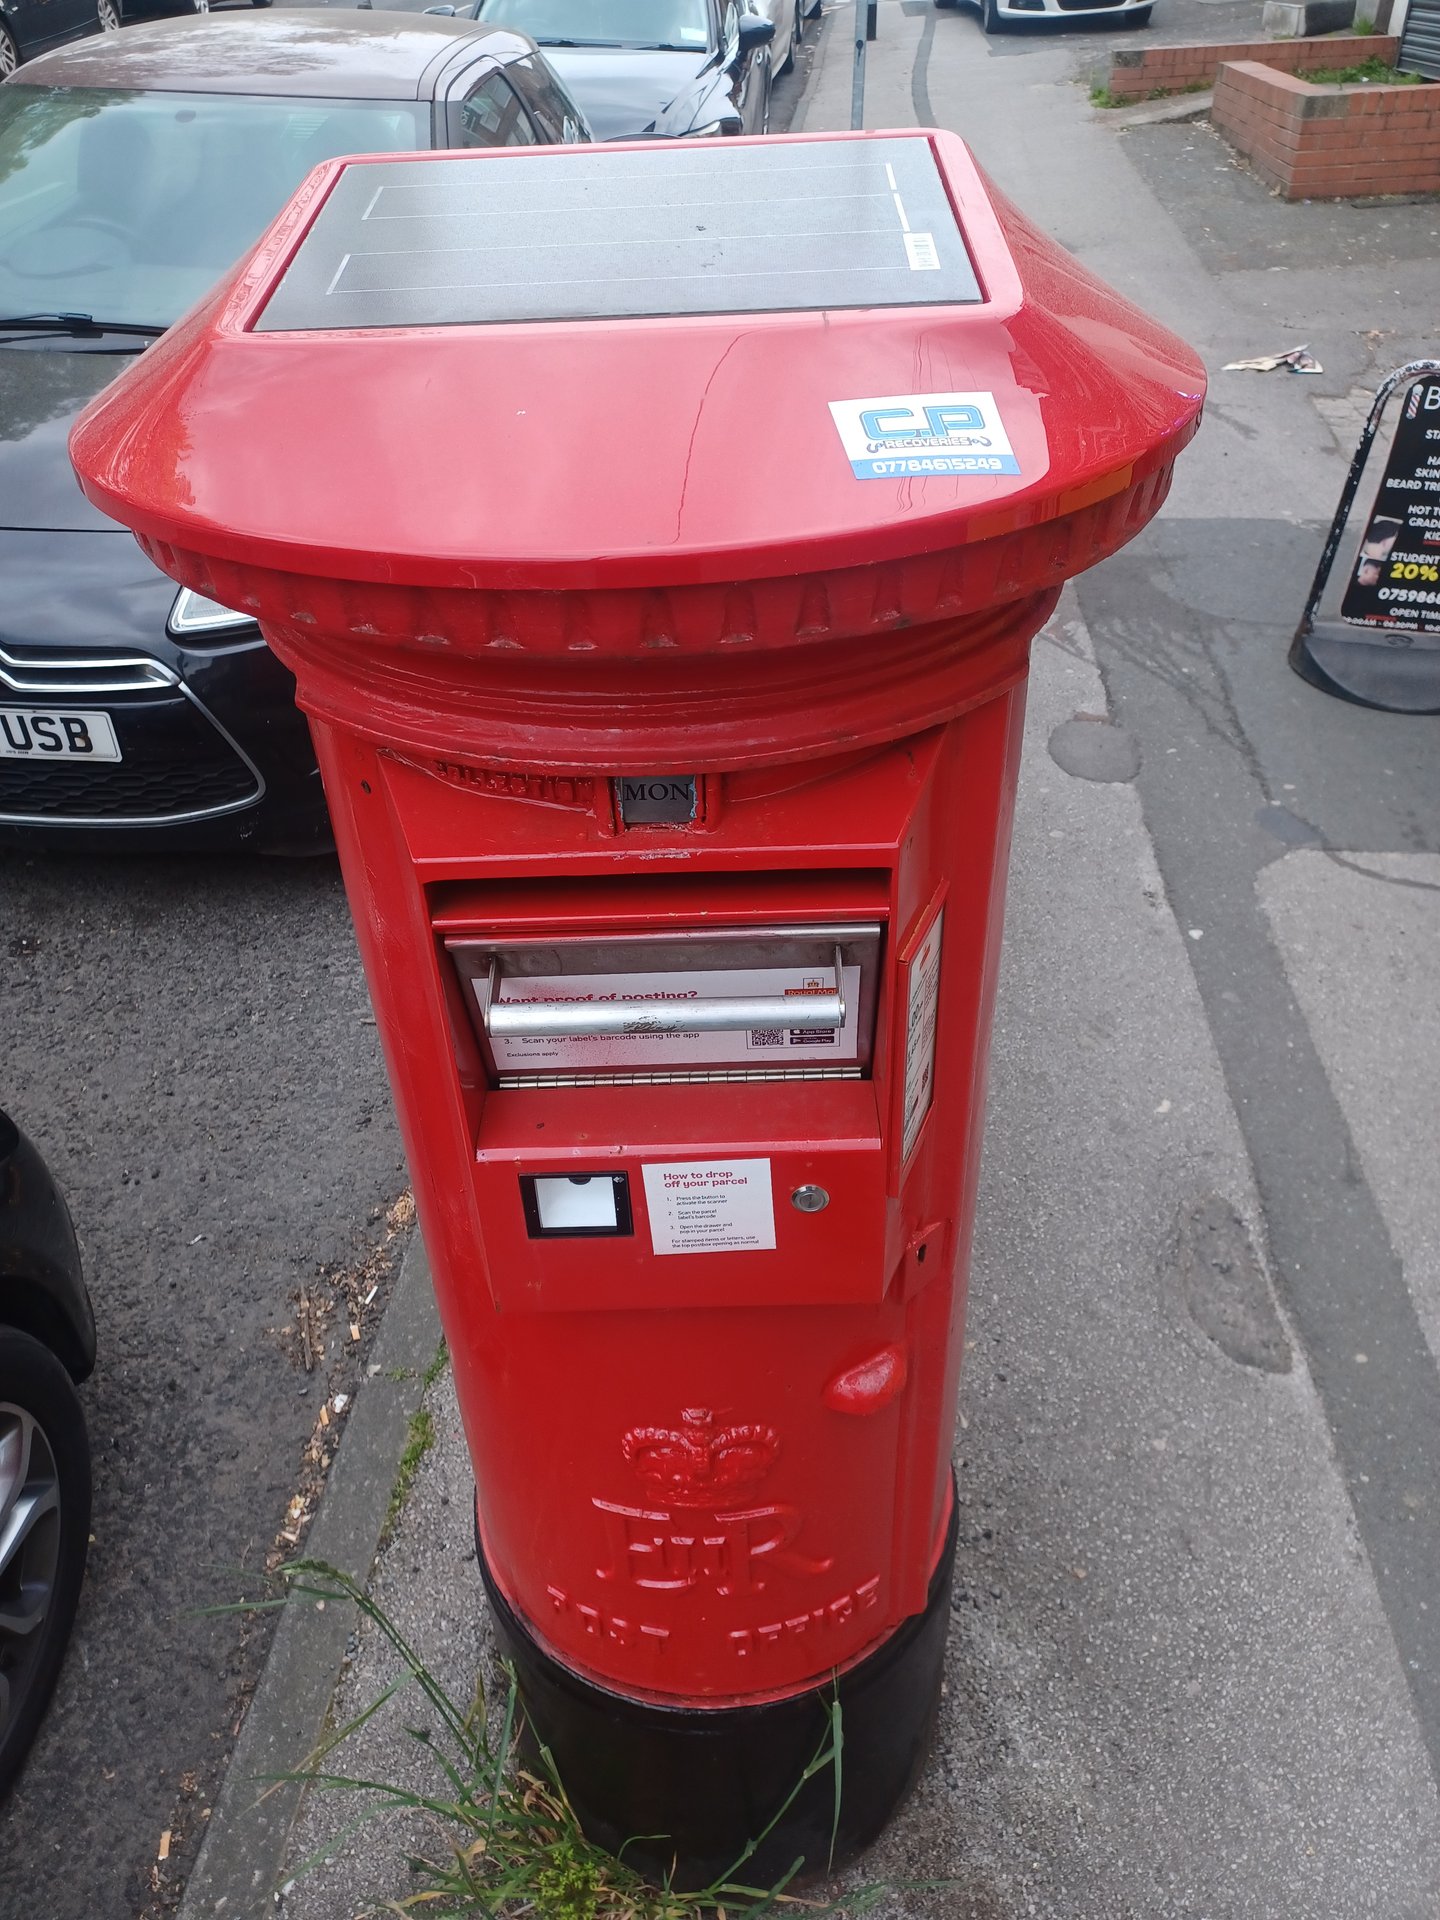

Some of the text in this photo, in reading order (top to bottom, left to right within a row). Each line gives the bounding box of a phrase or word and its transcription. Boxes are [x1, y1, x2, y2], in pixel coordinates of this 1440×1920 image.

[884, 437, 972, 449] RECOVERIES
[872, 457, 1002, 474] 07784615249
[1386, 478, 1422, 490] BEARD
[1408, 504, 1440, 516] HOT T
[1390, 552, 1440, 565] STUDENT
[1390, 562, 1439, 581] 20%
[1389, 607, 1419, 618] OPEN
[0, 715, 93, 753] USB
[624, 783, 690, 801] MON
[600, 1033, 636, 1041] barcode
[665, 1177, 747, 1188] off your parcel
